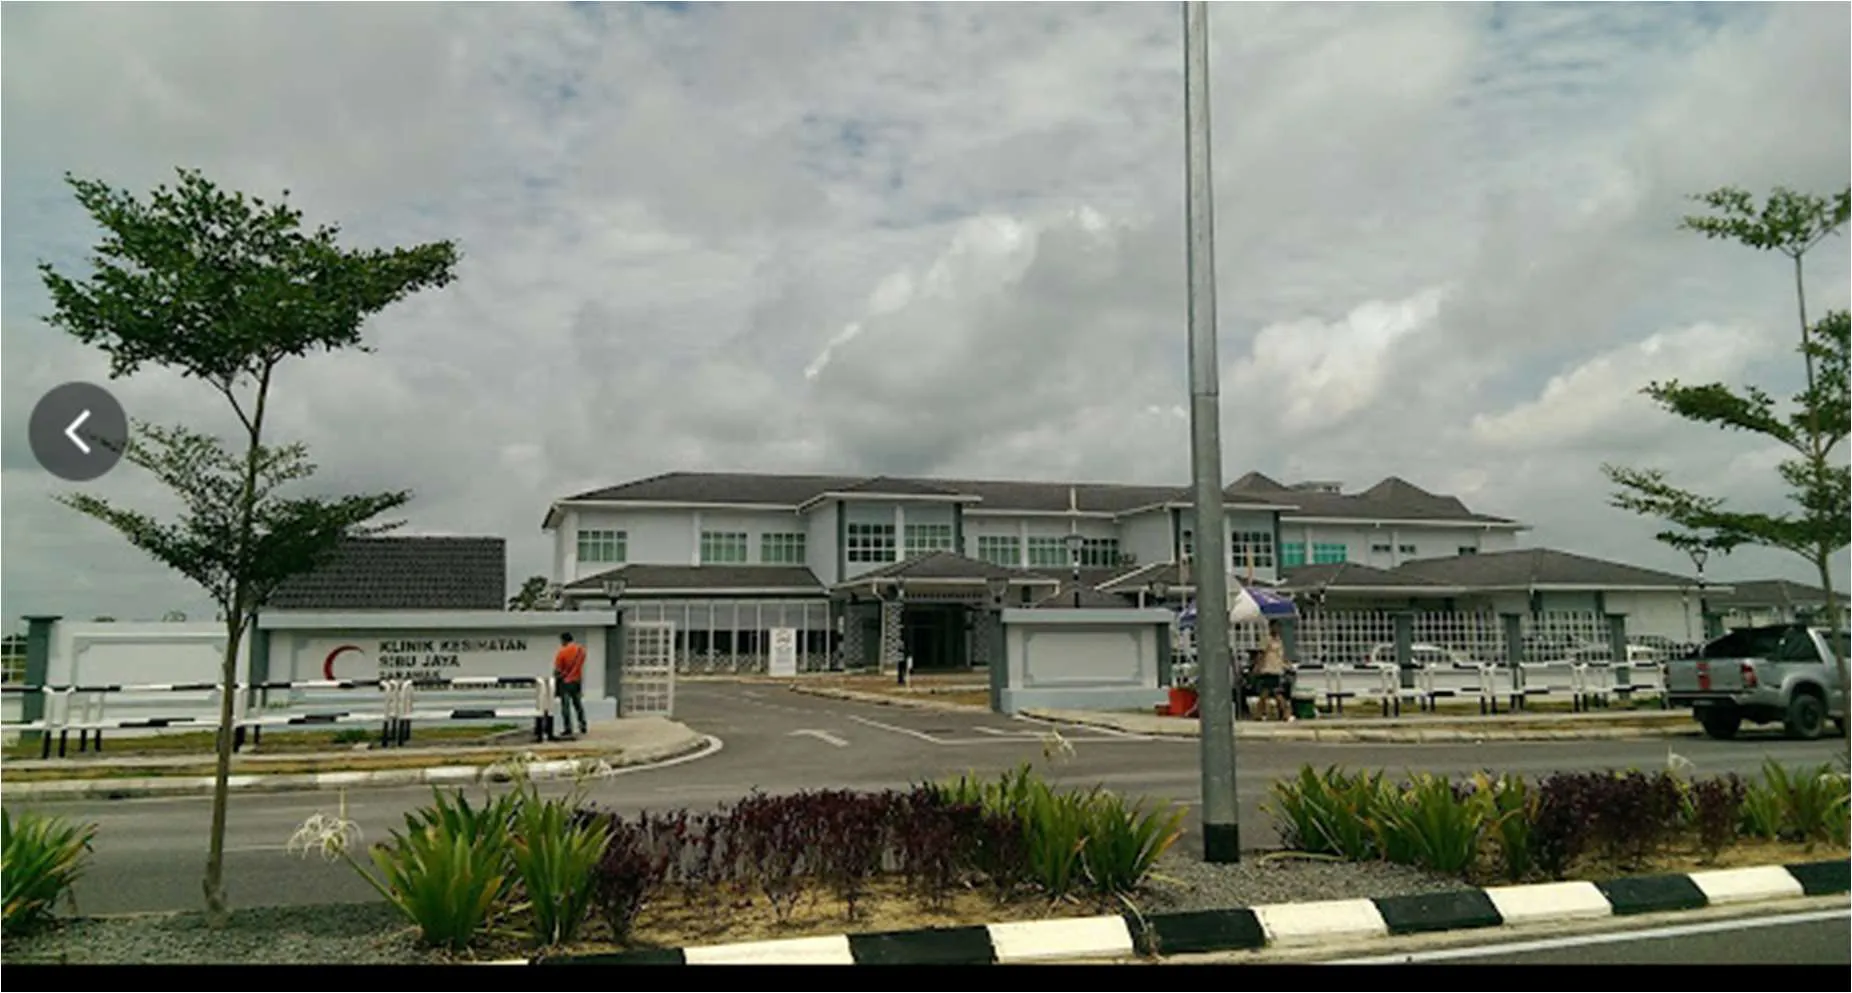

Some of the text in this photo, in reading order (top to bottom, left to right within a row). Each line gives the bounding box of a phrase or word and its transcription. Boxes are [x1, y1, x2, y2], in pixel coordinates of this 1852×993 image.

[379, 639, 527, 653] KLINIK KESIHATAN
[379, 654, 461, 668] SIBU JAYA
